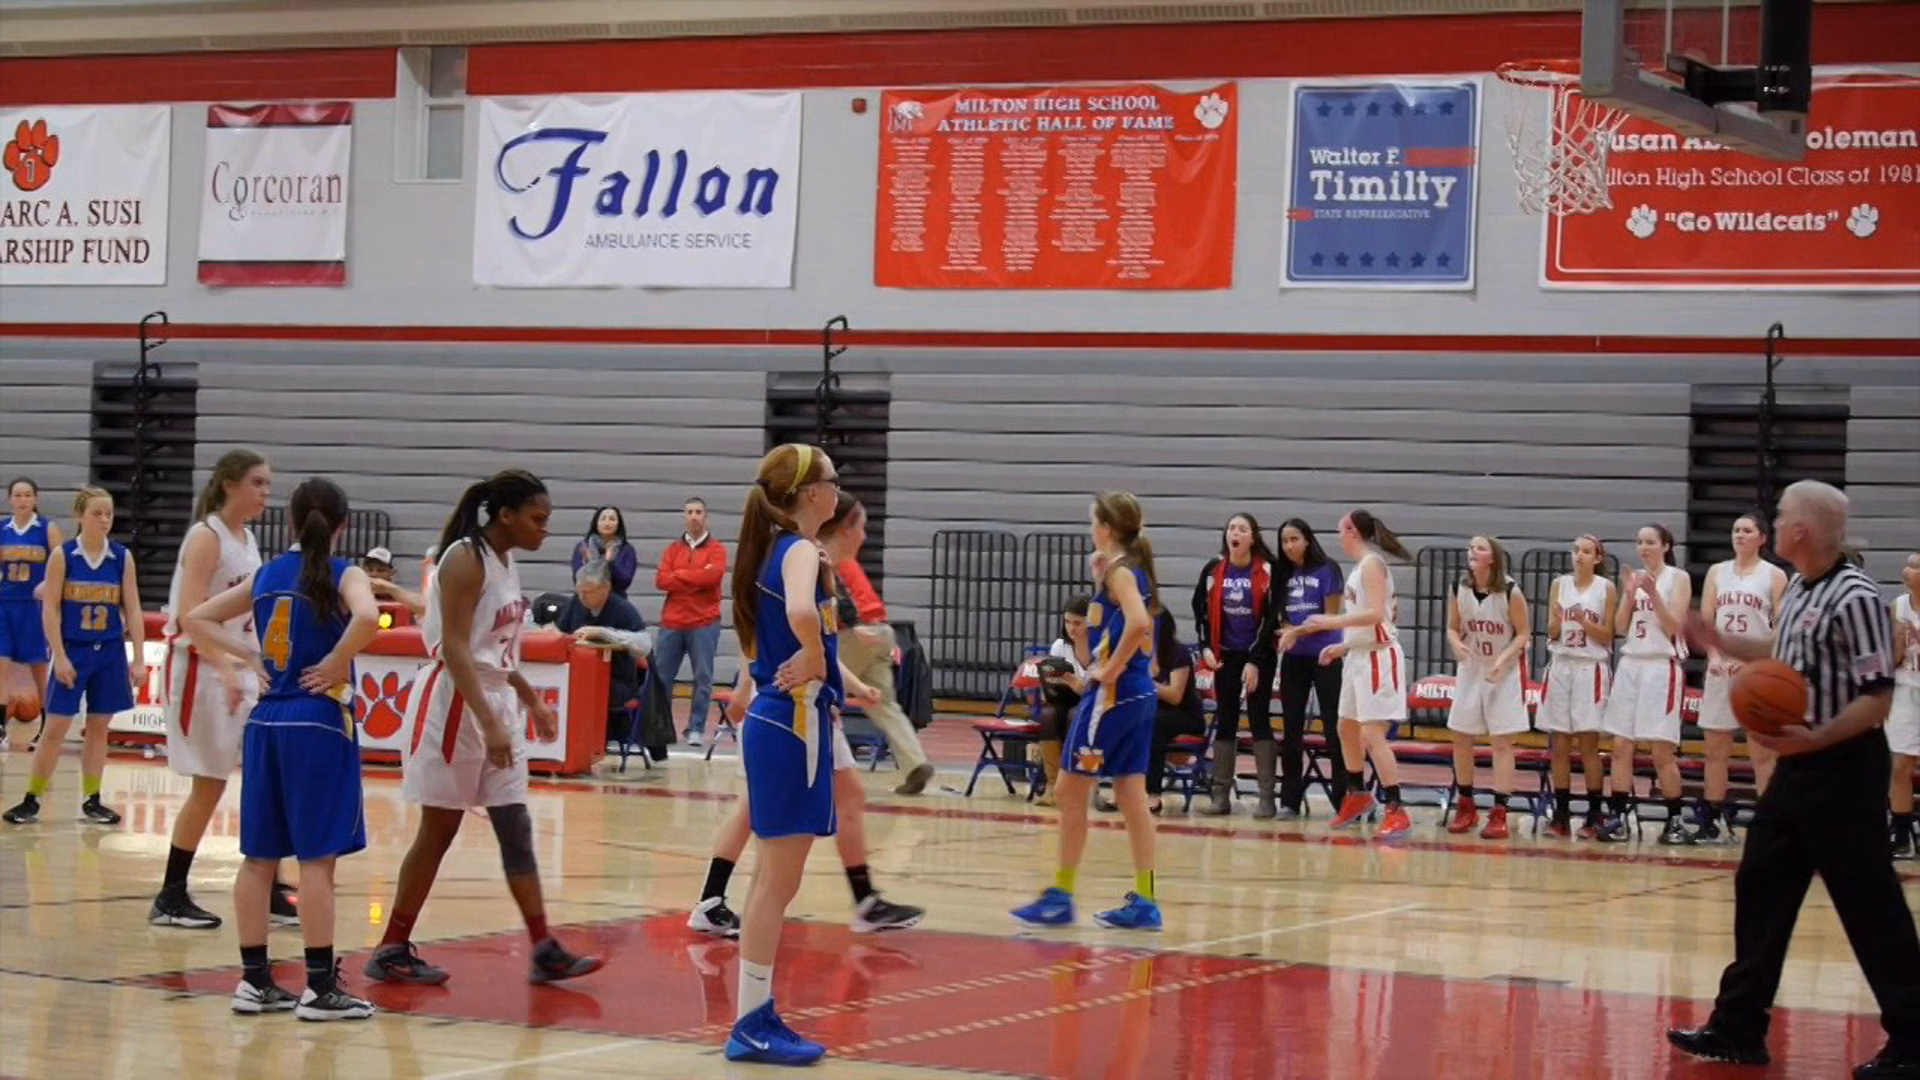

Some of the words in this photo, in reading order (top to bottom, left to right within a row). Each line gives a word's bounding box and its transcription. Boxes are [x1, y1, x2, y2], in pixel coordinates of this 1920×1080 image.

[954, 98, 1027, 114] MILTON
[1034, 97, 1081, 112] HIGH
[1087, 95, 1160, 111] SCHOOL
[936, 117, 1032, 133] ATHLETIC
[1036, 116, 1087, 131] HALL
[1092, 116, 1117, 130] OF
[1121, 115, 1176, 130] FAME
[1805, 126, 1918, 149] oleman
[1309, 147, 1381, 165] Walter
[211, 161, 342, 212] Corcoran
[497, 127, 780, 240] Fallon
[1605, 167, 1651, 186] lton
[1655, 167, 1706, 190] High
[1710, 167, 1783, 186] School
[1787, 166, 1845, 186] Class
[1848, 167, 1870, 184] of
[1880, 163, 1920, 183] 1981
[1309, 169, 1458, 208] Timilty
[56, 199, 79, 227] A.
[87, 199, 142, 227] SUSI
[0, 239, 74, 264] RSHIP
[82, 239, 150, 264] FUND
[584, 232, 681, 249] AMBULANCE
[684, 231, 752, 249] SERVICE
[262, 596, 294, 672] 4
[1635, 620, 1647, 639] 5
[1724, 614, 1748, 633] 25
[1565, 628, 1588, 648] 23
